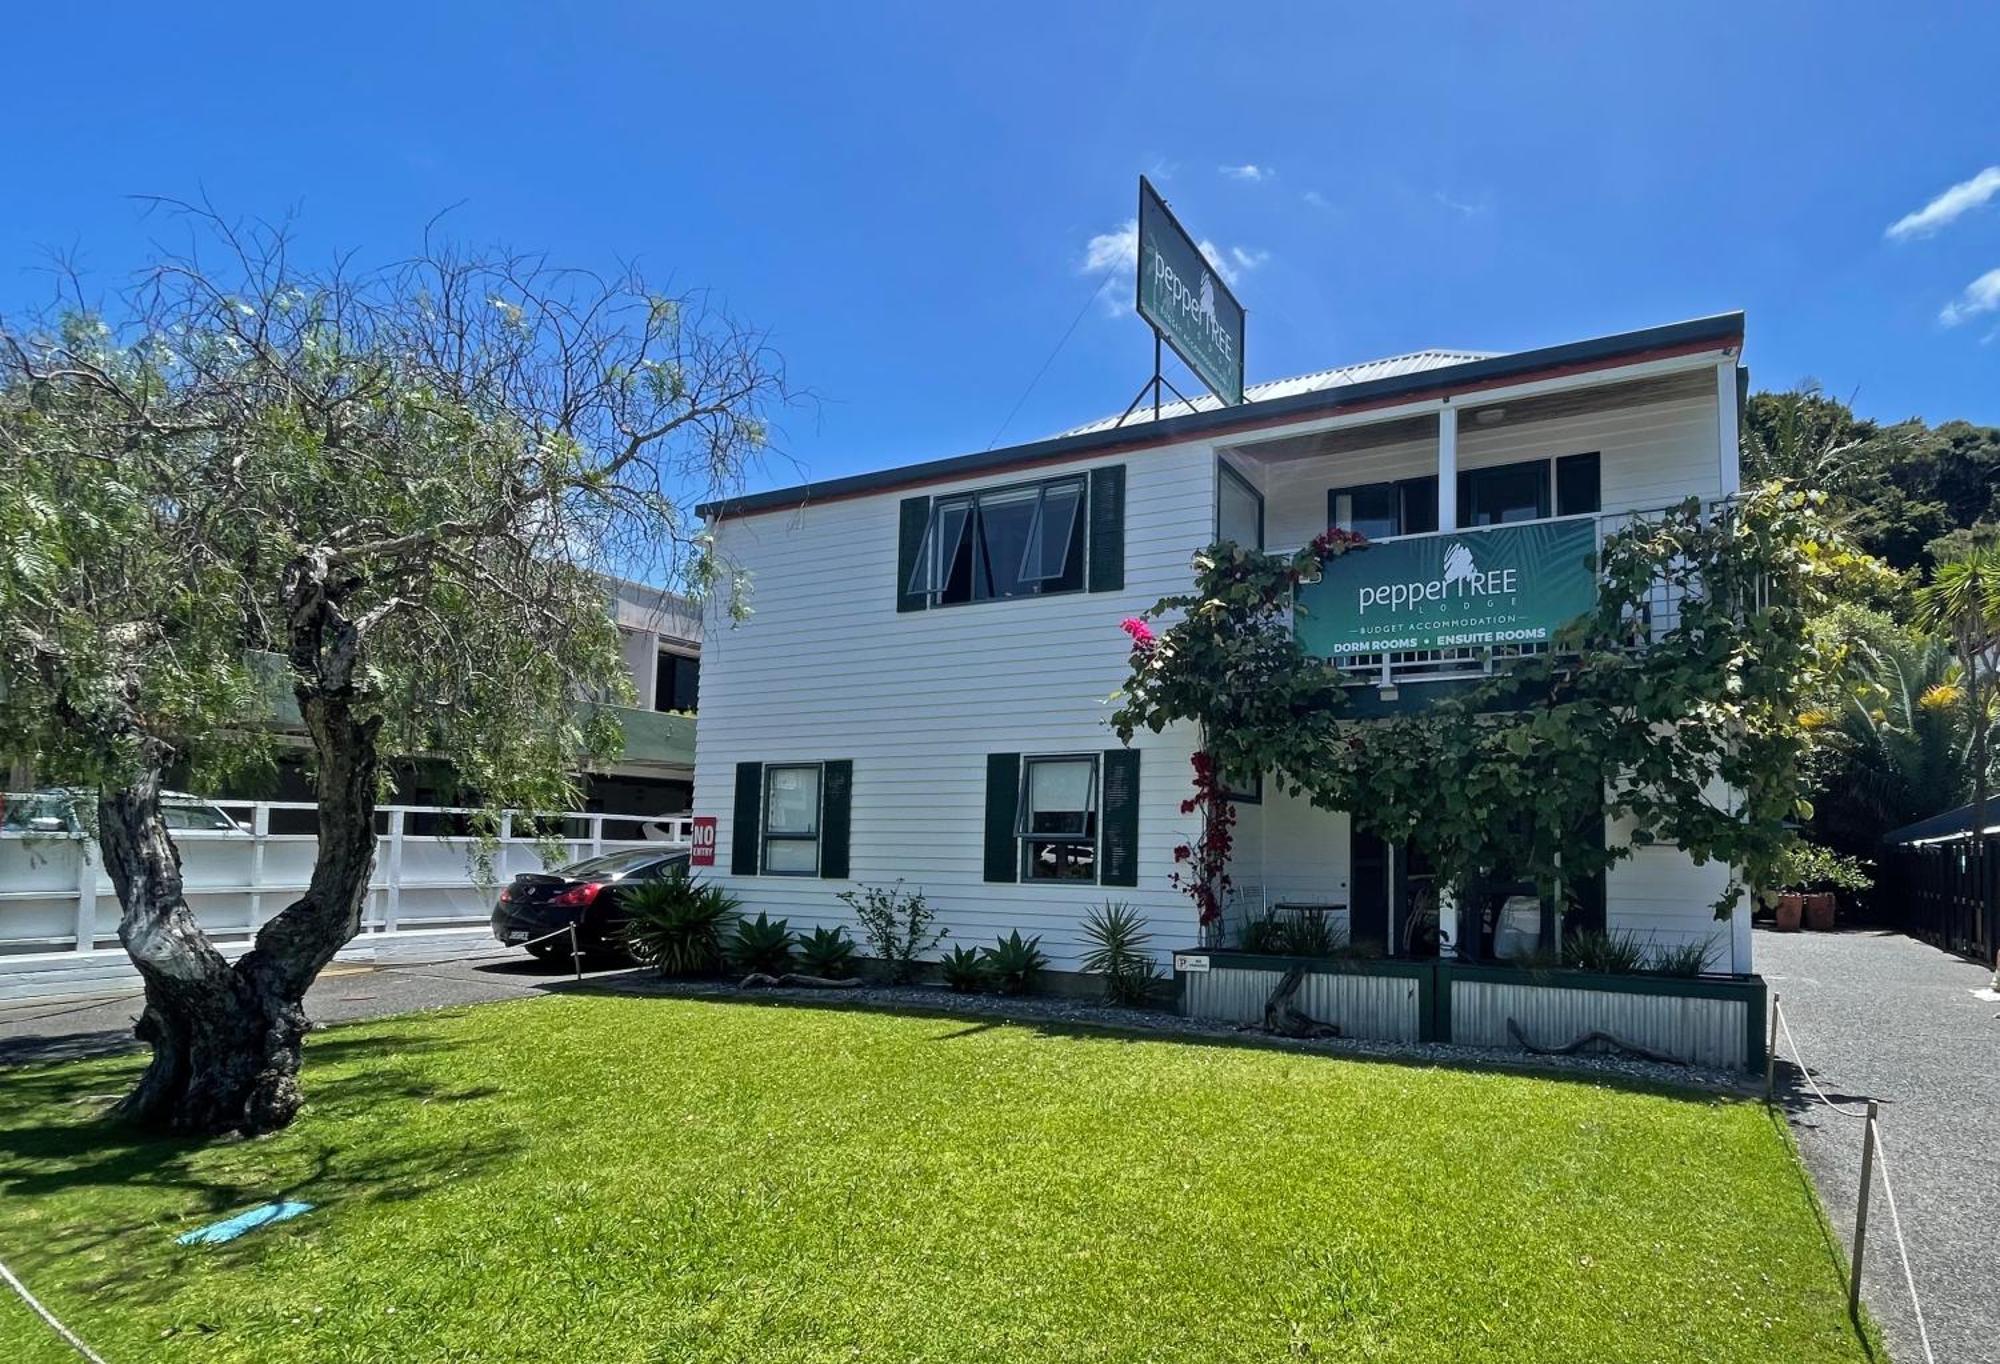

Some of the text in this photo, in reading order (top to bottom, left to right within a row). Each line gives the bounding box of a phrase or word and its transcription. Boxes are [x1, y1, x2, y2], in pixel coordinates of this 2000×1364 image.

[1155, 250, 1232, 362] pepperTREE
[1360, 568, 1517, 615] pepperTREE
[1419, 597, 1517, 614] LODGE
[1360, 615, 1516, 635] BUDGET ACCOMMODATION
[1333, 627, 1546, 653] DORM ROOMS ENSUITE ROOMS
[694, 825, 714, 846] NO
